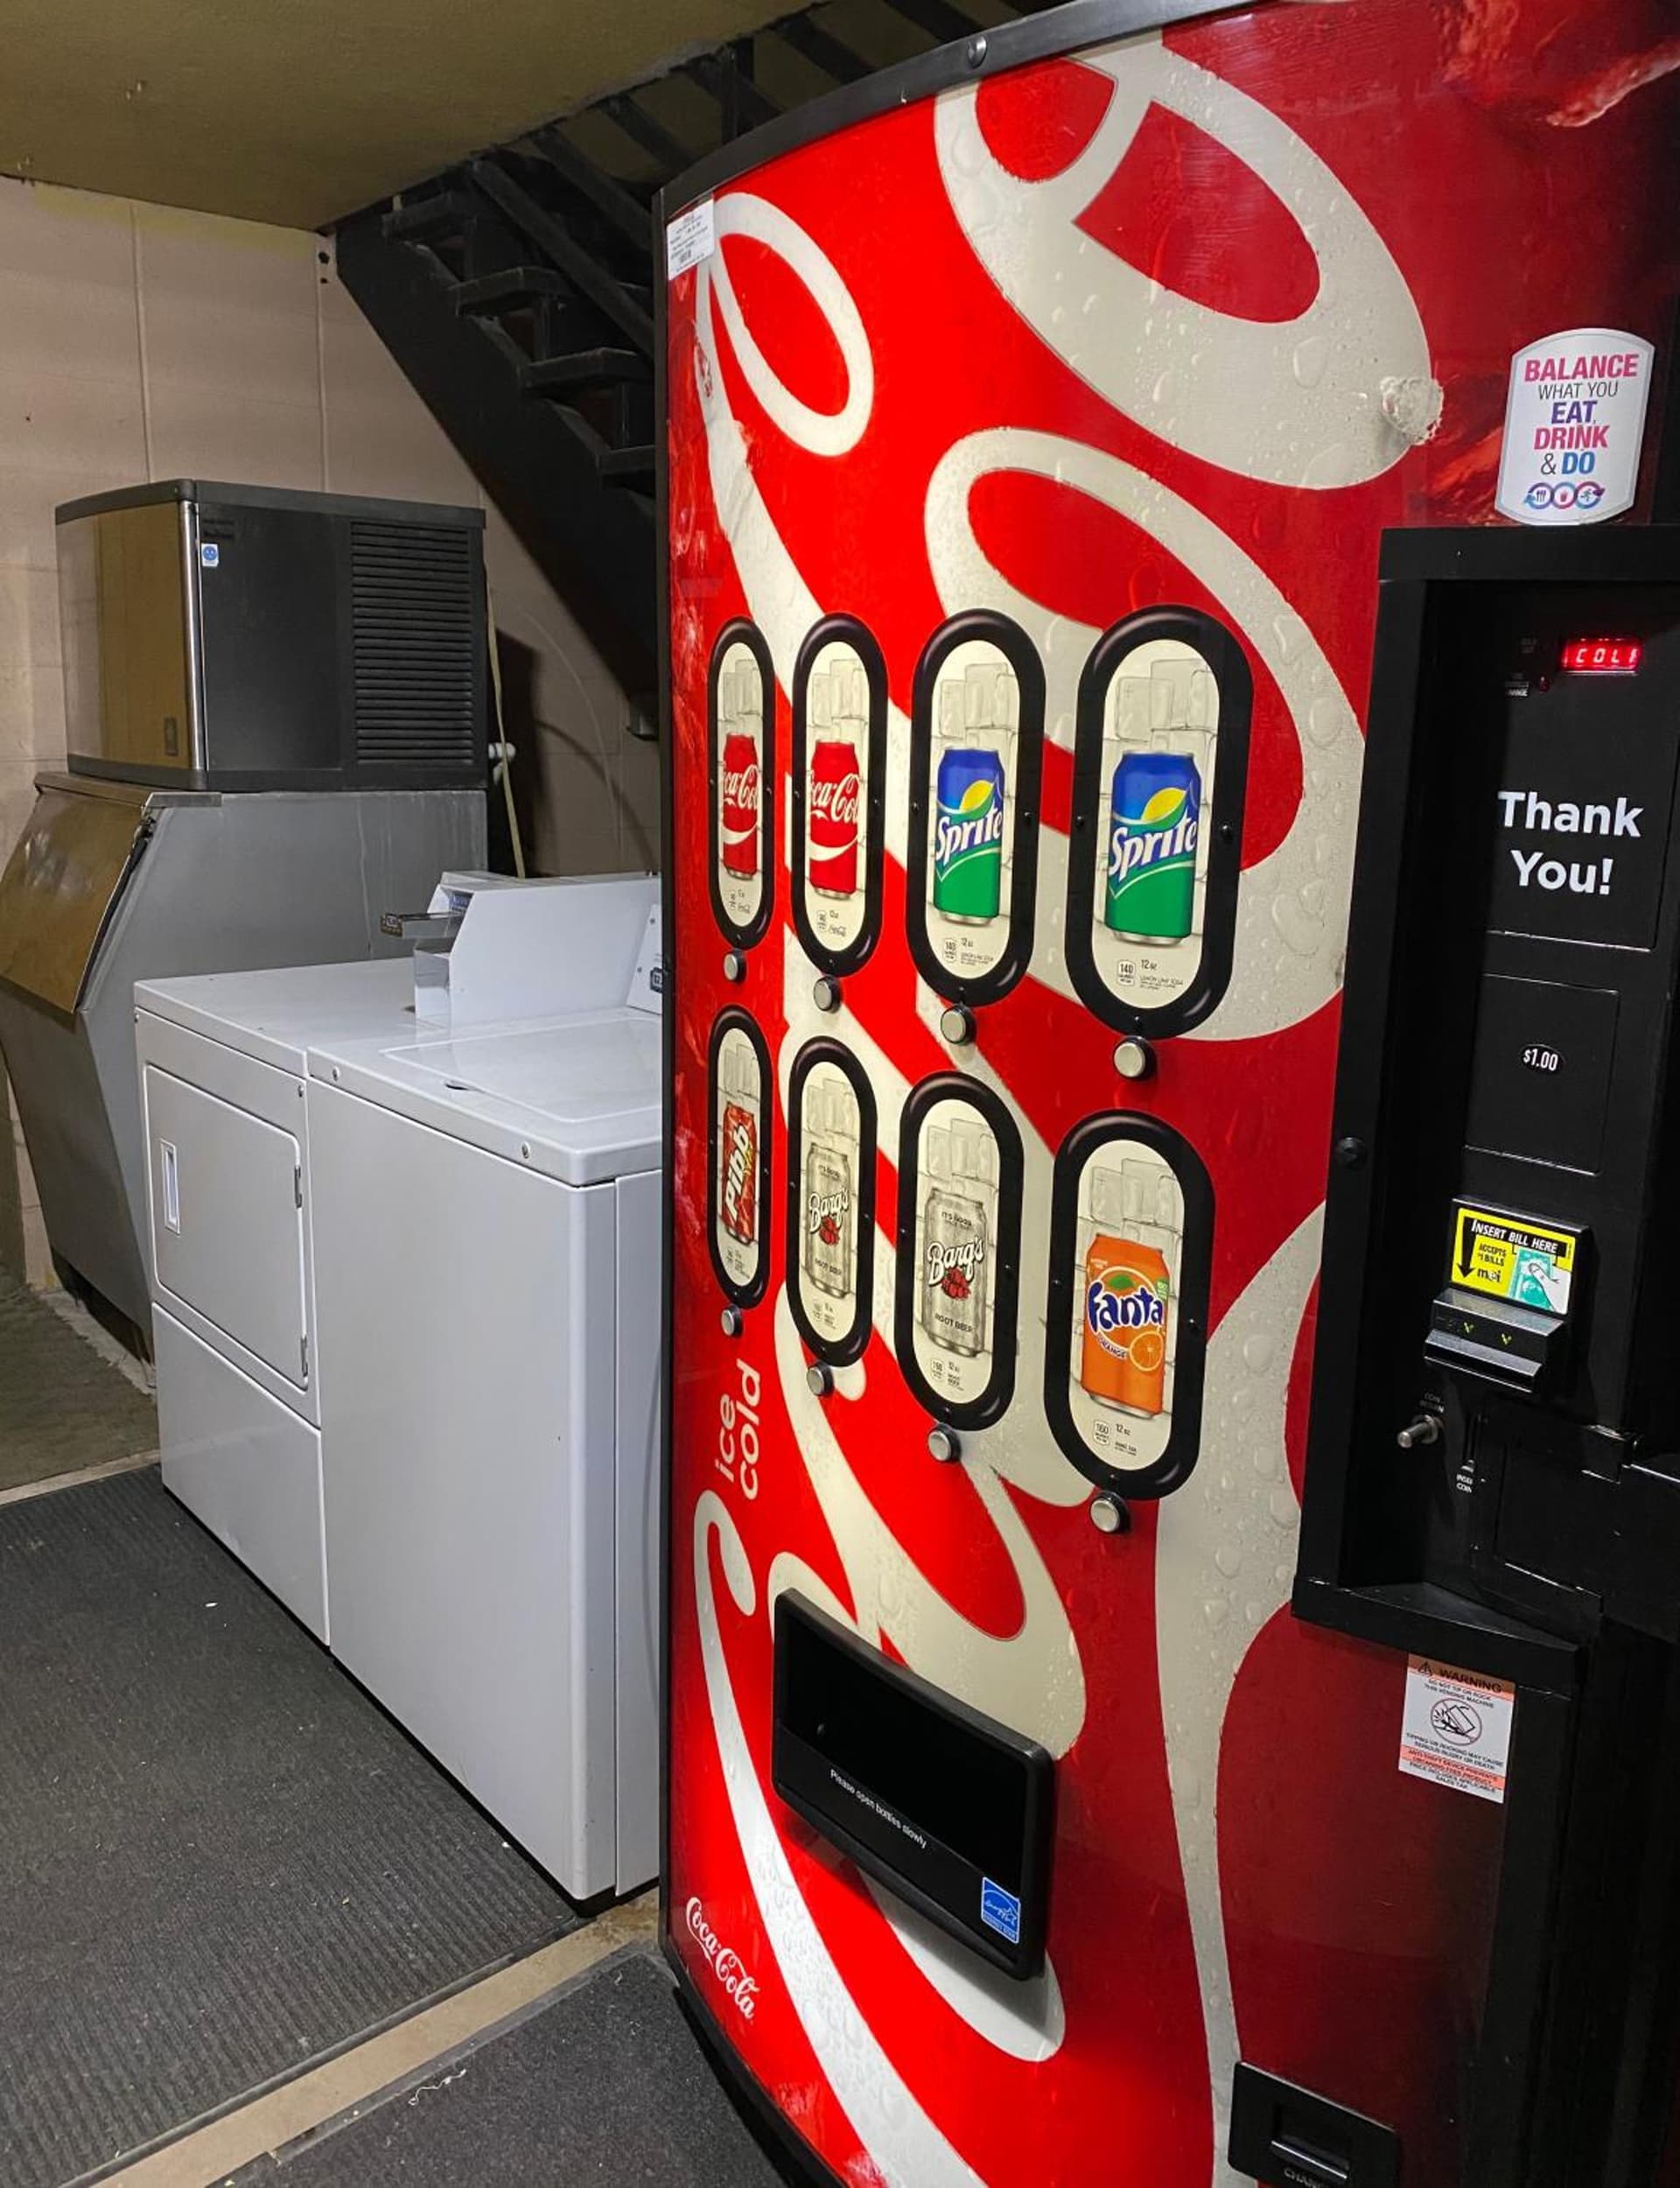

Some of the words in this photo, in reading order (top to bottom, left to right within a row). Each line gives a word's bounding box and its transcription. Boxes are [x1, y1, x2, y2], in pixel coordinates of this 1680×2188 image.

[1525, 354, 1639, 382] BALANCE
[1538, 382, 1582, 400] WHAT
[1589, 382, 1619, 397] YOU
[1551, 401, 1597, 424] EAT,
[1534, 425, 1610, 450] DRINK
[1540, 452, 1557, 475] &
[1562, 452, 1595, 474] DO
[936, 797, 1002, 866] Sprite
[1498, 791, 1643, 838] Thank
[1109, 806, 1196, 882] Sprite
[1510, 849, 1614, 895] You!
[1120, 964, 1133, 974] 140
[1141, 959, 1149, 969] 12
[1523, 1048, 1558, 1071] $1.00
[808, 1186, 849, 1234] Barq's
[1471, 1219, 1507, 1239] INSERT
[1509, 1231, 1529, 1246] BILL
[1532, 1238, 1558, 1253] HERE
[928, 1235, 984, 1287] Barq's
[1477, 1268, 1502, 1282] mei
[714, 1393, 736, 1483] ice
[739, 1357, 761, 1500] cold
[1439, 1667, 1502, 1694] WARNING
[830, 1769, 855, 1793] Please
[856, 1790, 875, 1808] open
[876, 1803, 901, 1828] bottles
[902, 1825, 927, 1849] slowly
[686, 1897, 760, 2020] Coca-Cola
